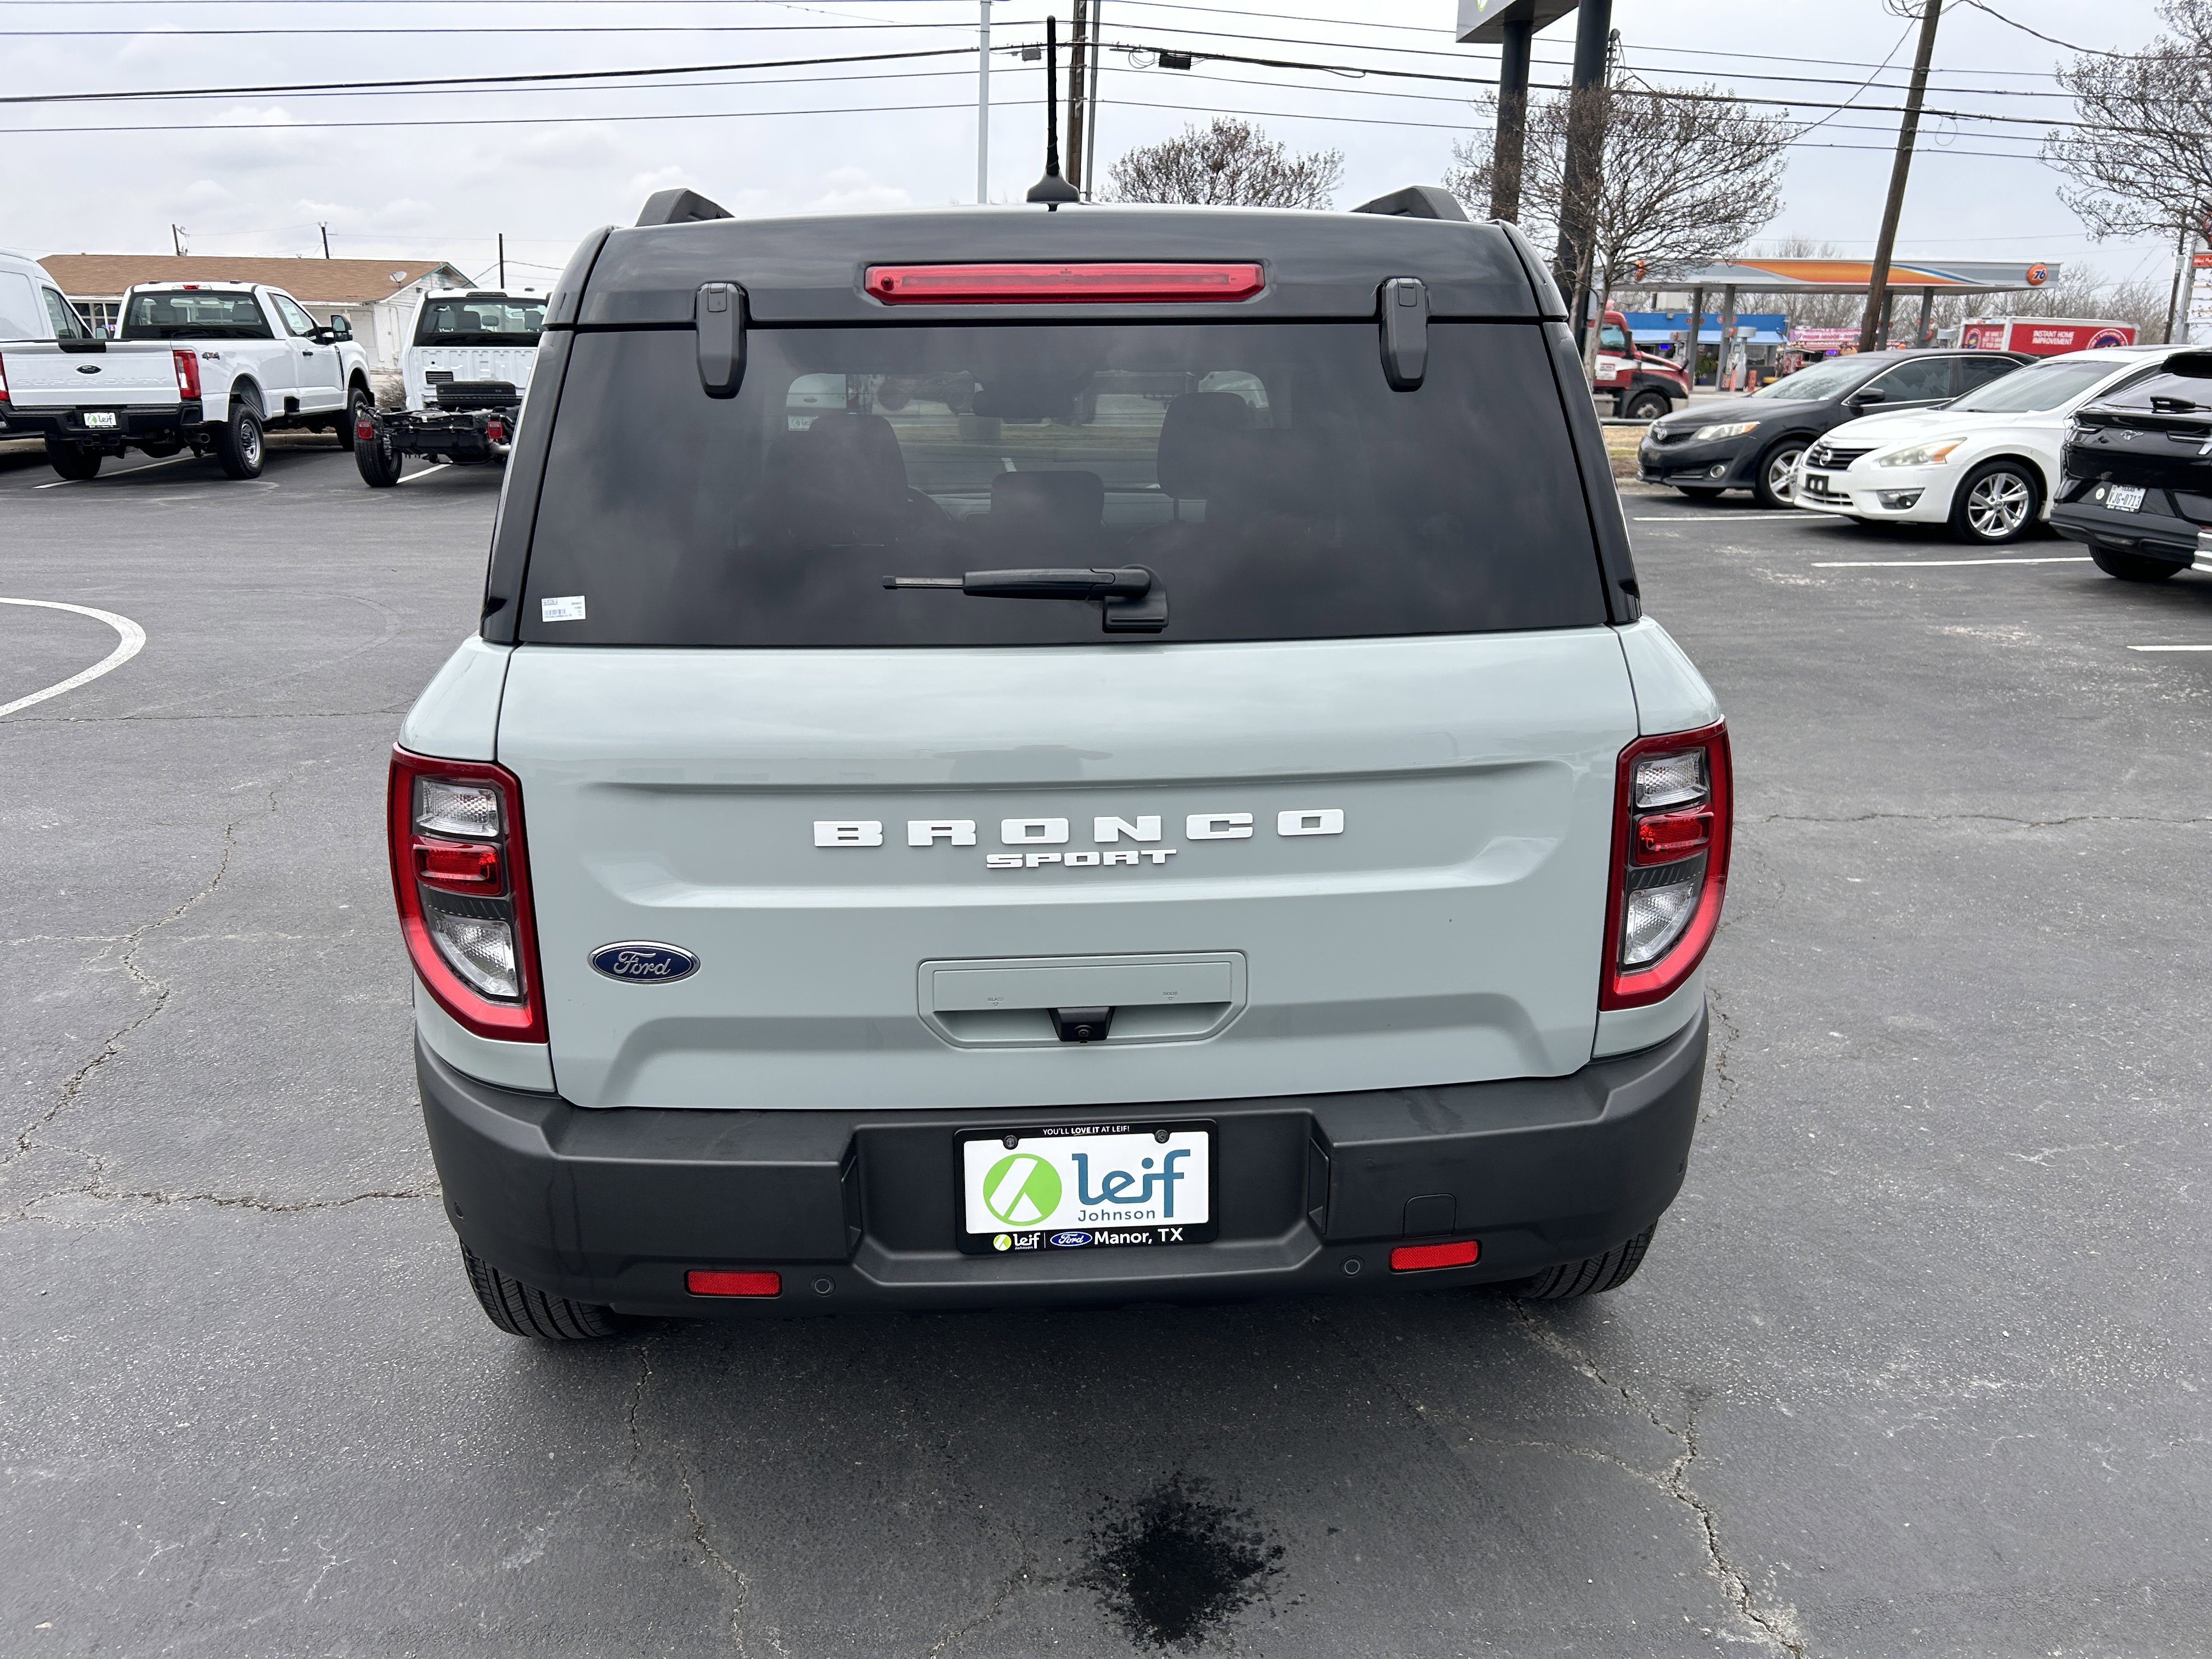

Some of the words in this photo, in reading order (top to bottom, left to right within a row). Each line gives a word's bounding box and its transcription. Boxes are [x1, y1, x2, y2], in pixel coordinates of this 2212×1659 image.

[2033, 269, 2046, 279] 76
[2032, 337, 2073, 345] IMPROVEMENT
[16, 378, 98, 386] SUPER
[98, 415, 112, 424] leif
[813, 809, 1344, 847] BRONCO
[986, 849, 1177, 868] SPORT
[613, 951, 672, 975] Ford
[1043, 1127, 1069, 1136] YOU'LL
[1071, 1149, 1190, 1218] leif
[1077, 1209, 1155, 1222] Johnson
[1013, 1232, 1041, 1249] leif
[1058, 1233, 1084, 1244] Ford
[1094, 1231, 1152, 1245] Manor,
[1158, 1227, 1183, 1242] TX
